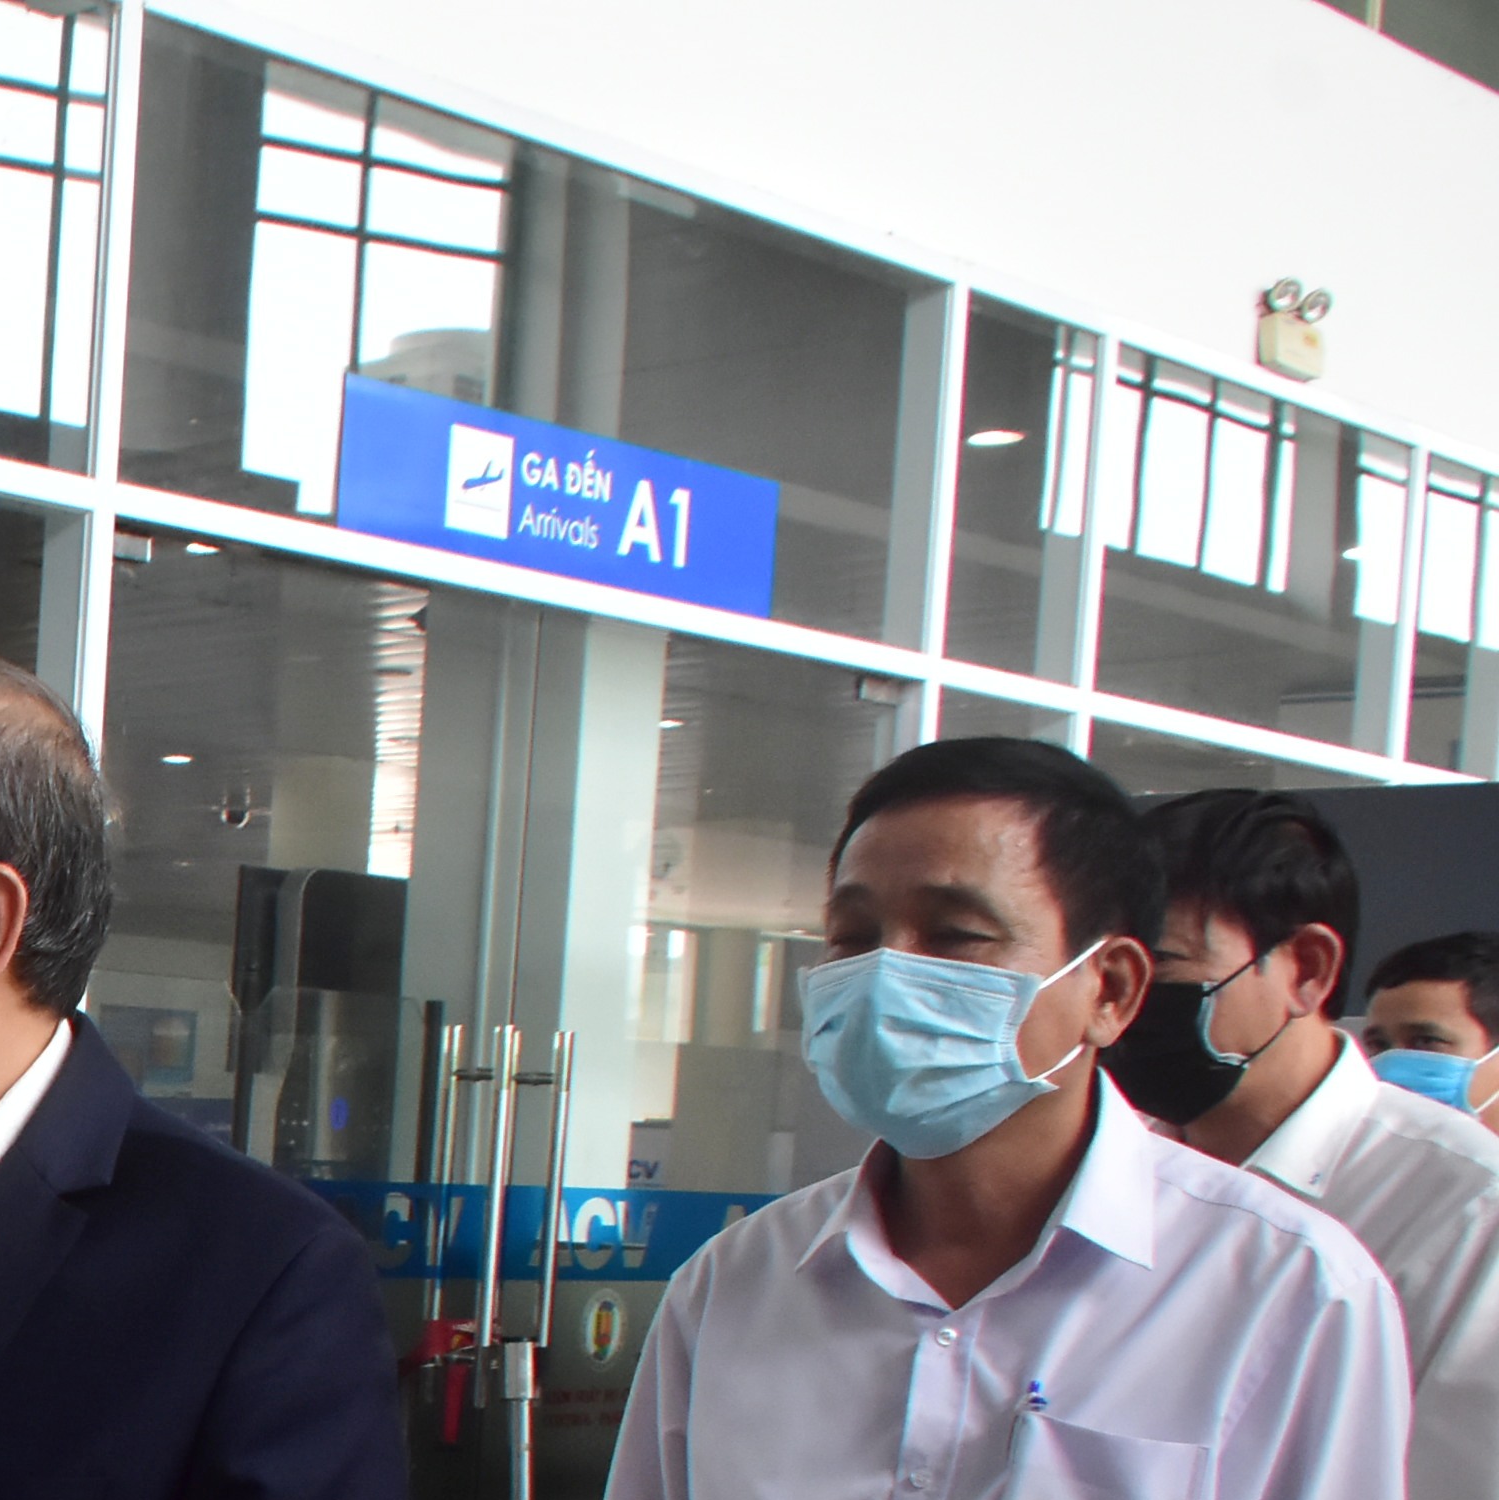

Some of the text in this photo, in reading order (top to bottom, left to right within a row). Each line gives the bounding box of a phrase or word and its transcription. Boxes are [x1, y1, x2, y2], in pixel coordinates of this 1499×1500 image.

[520, 449, 612, 502] GA ĐẾN
[518, 503, 600, 549] Arrivals
[616, 479, 693, 568] A1
